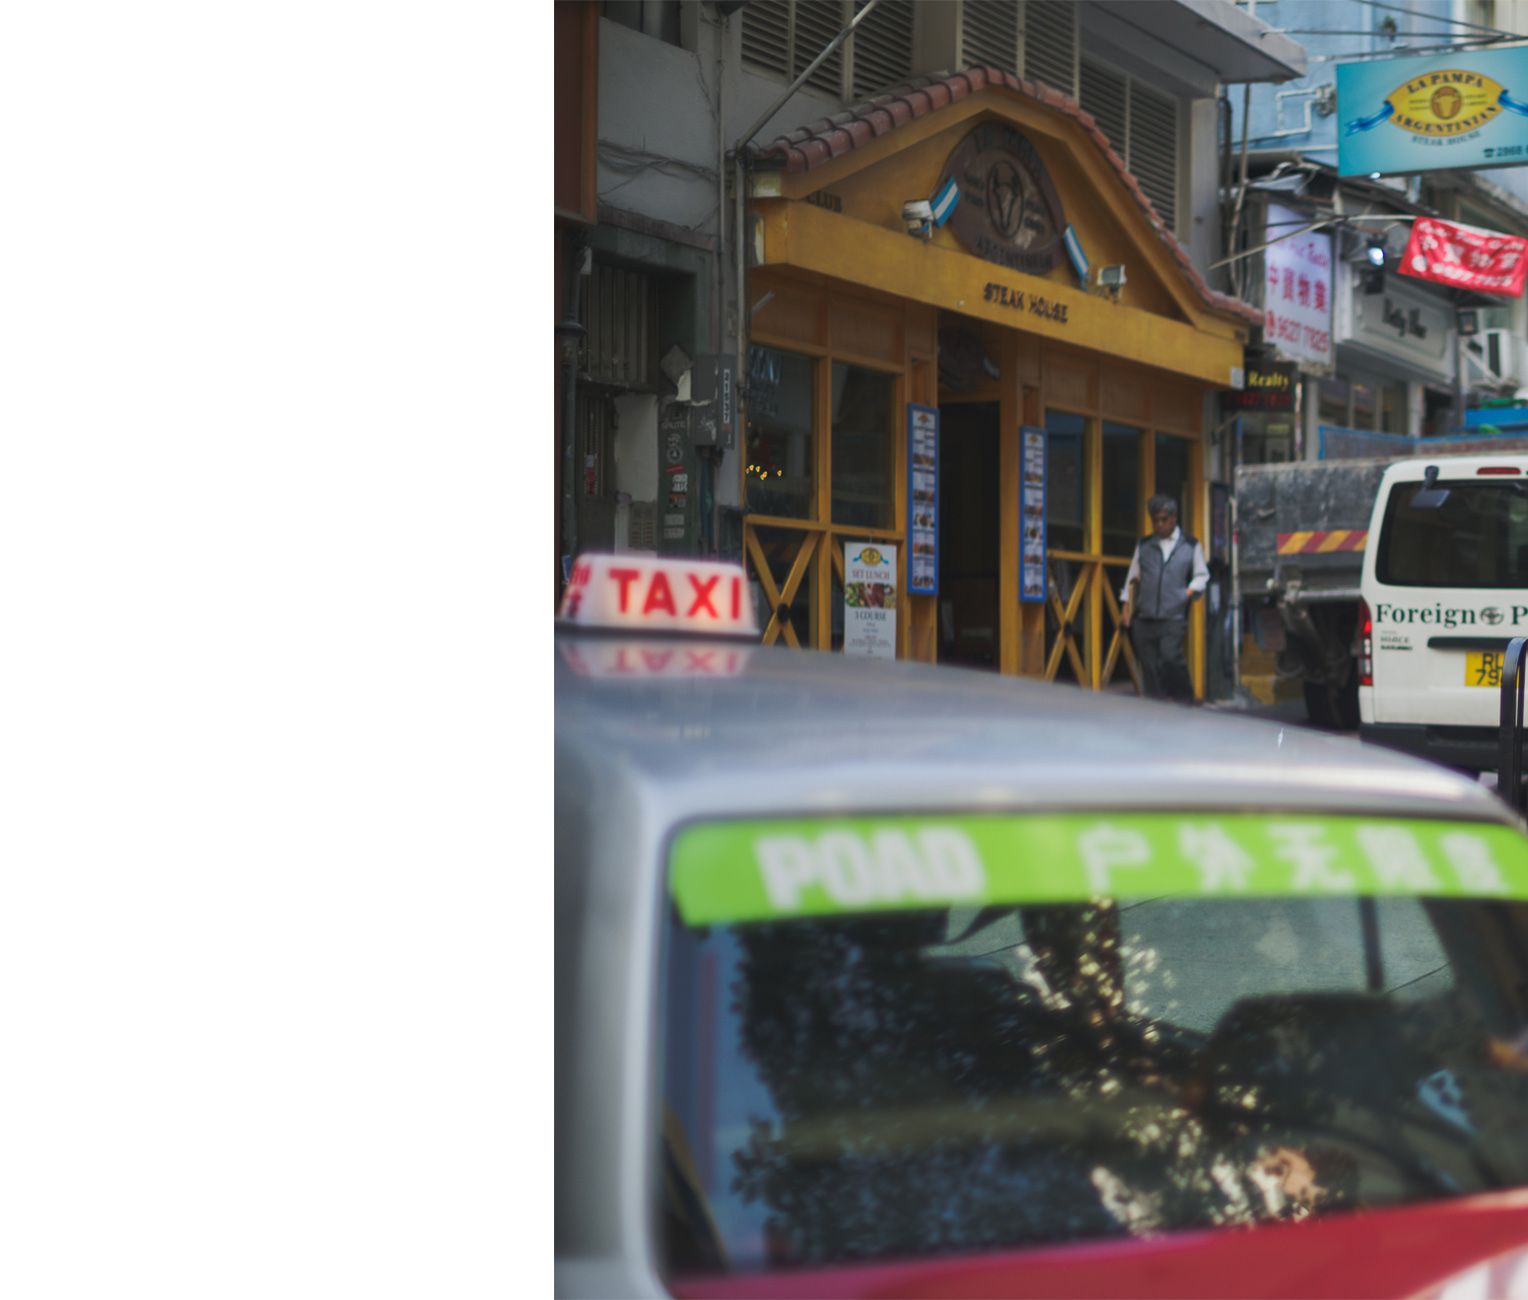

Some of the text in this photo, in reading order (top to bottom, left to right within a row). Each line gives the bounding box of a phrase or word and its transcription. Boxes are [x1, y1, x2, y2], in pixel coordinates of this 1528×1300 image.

[1406, 73, 1483, 94] LA PAMPA
[1396, 106, 1498, 133] ARGENTINIAN
[983, 282, 1069, 323] STEAK HOUSE
[1248, 371, 1289, 391] Realty
[608, 568, 742, 621] TAXI
[1376, 603, 1476, 629] Foreign
[1380, 636, 1410, 644] HIACE
[1475, 669, 1507, 687] 79
[756, 828, 986, 910] POAD
